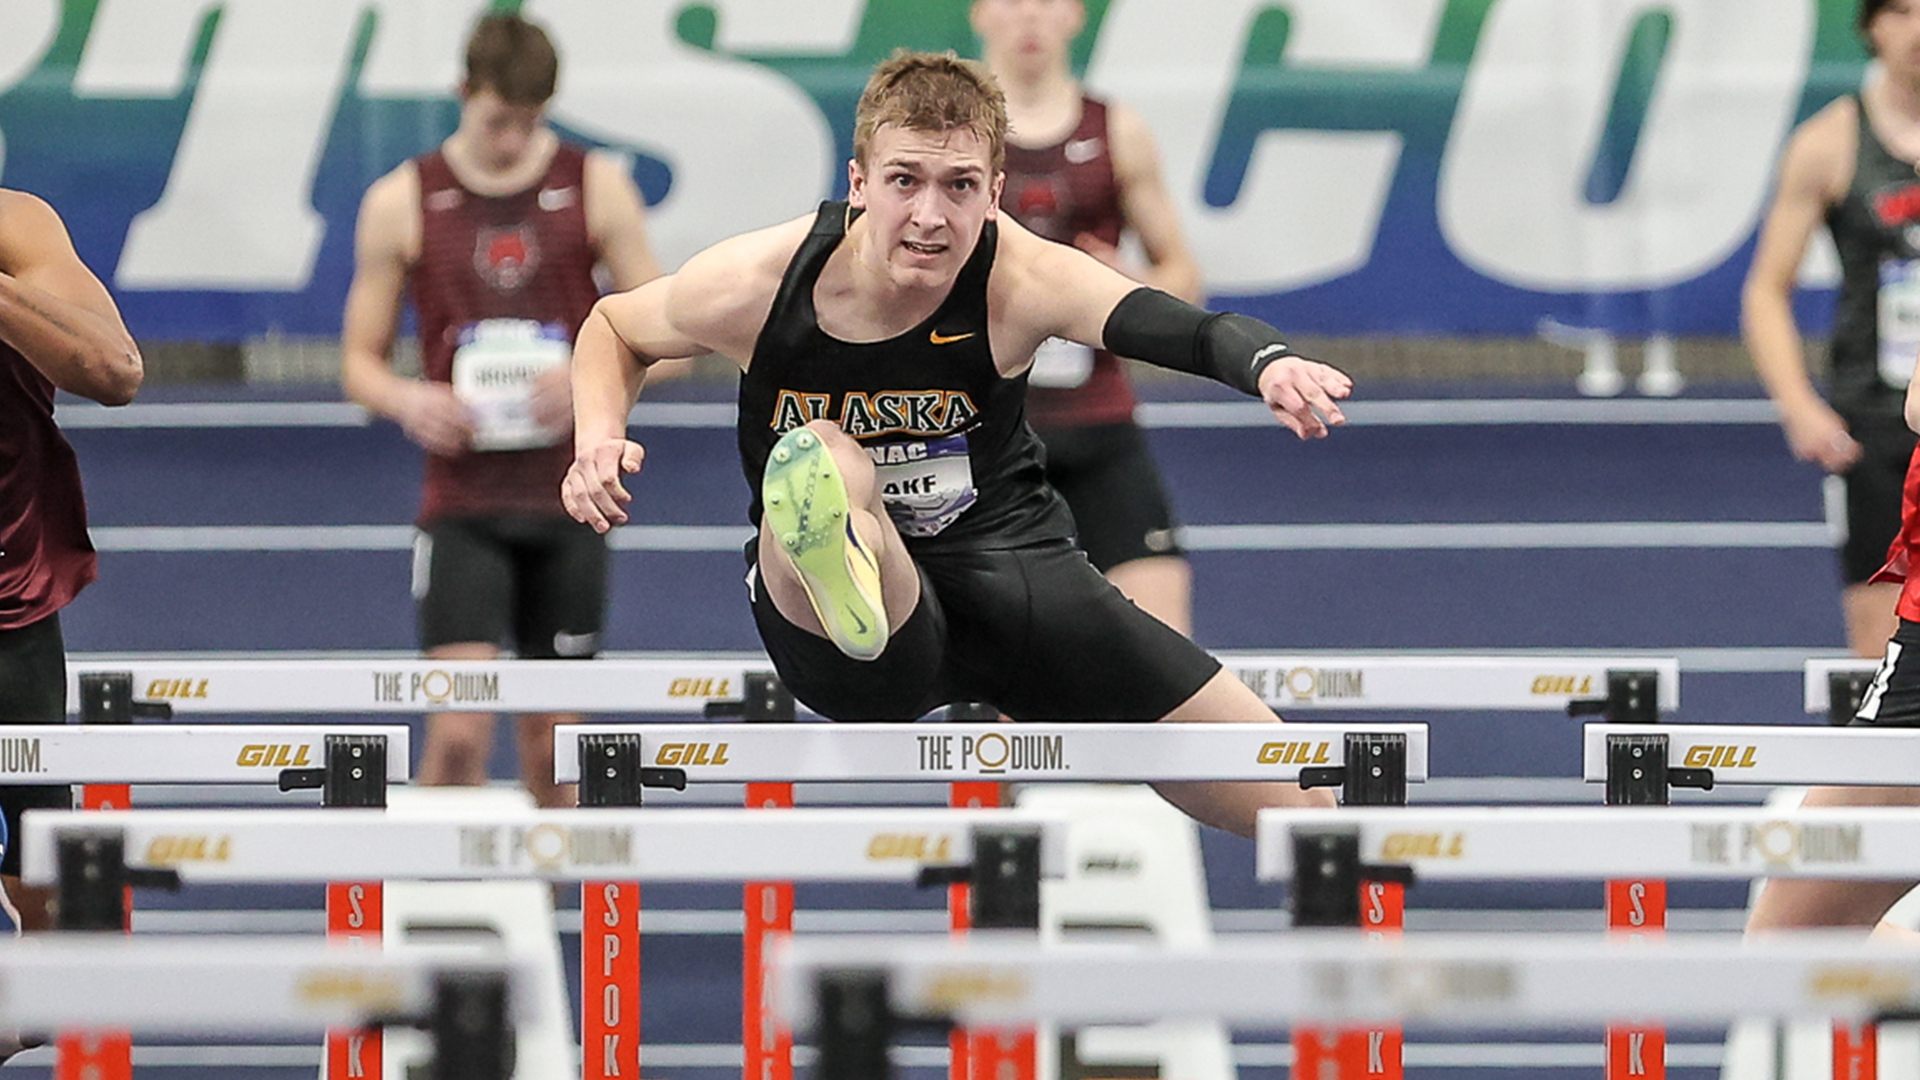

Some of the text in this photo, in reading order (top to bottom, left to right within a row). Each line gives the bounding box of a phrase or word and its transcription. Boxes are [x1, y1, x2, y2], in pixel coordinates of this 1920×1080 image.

[770, 389, 979, 438] ALASKA
[146, 679, 209, 699] GILL
[372, 671, 403, 701] THE
[667, 677, 730, 698] GILL
[1530, 674, 1593, 695] GILL
[236, 744, 311, 767] GILL
[655, 743, 730, 766] GILL
[917, 732, 1070, 774] THE PODIUM.
[1257, 742, 1331, 765] GILL
[1683, 745, 1757, 768] GILL
